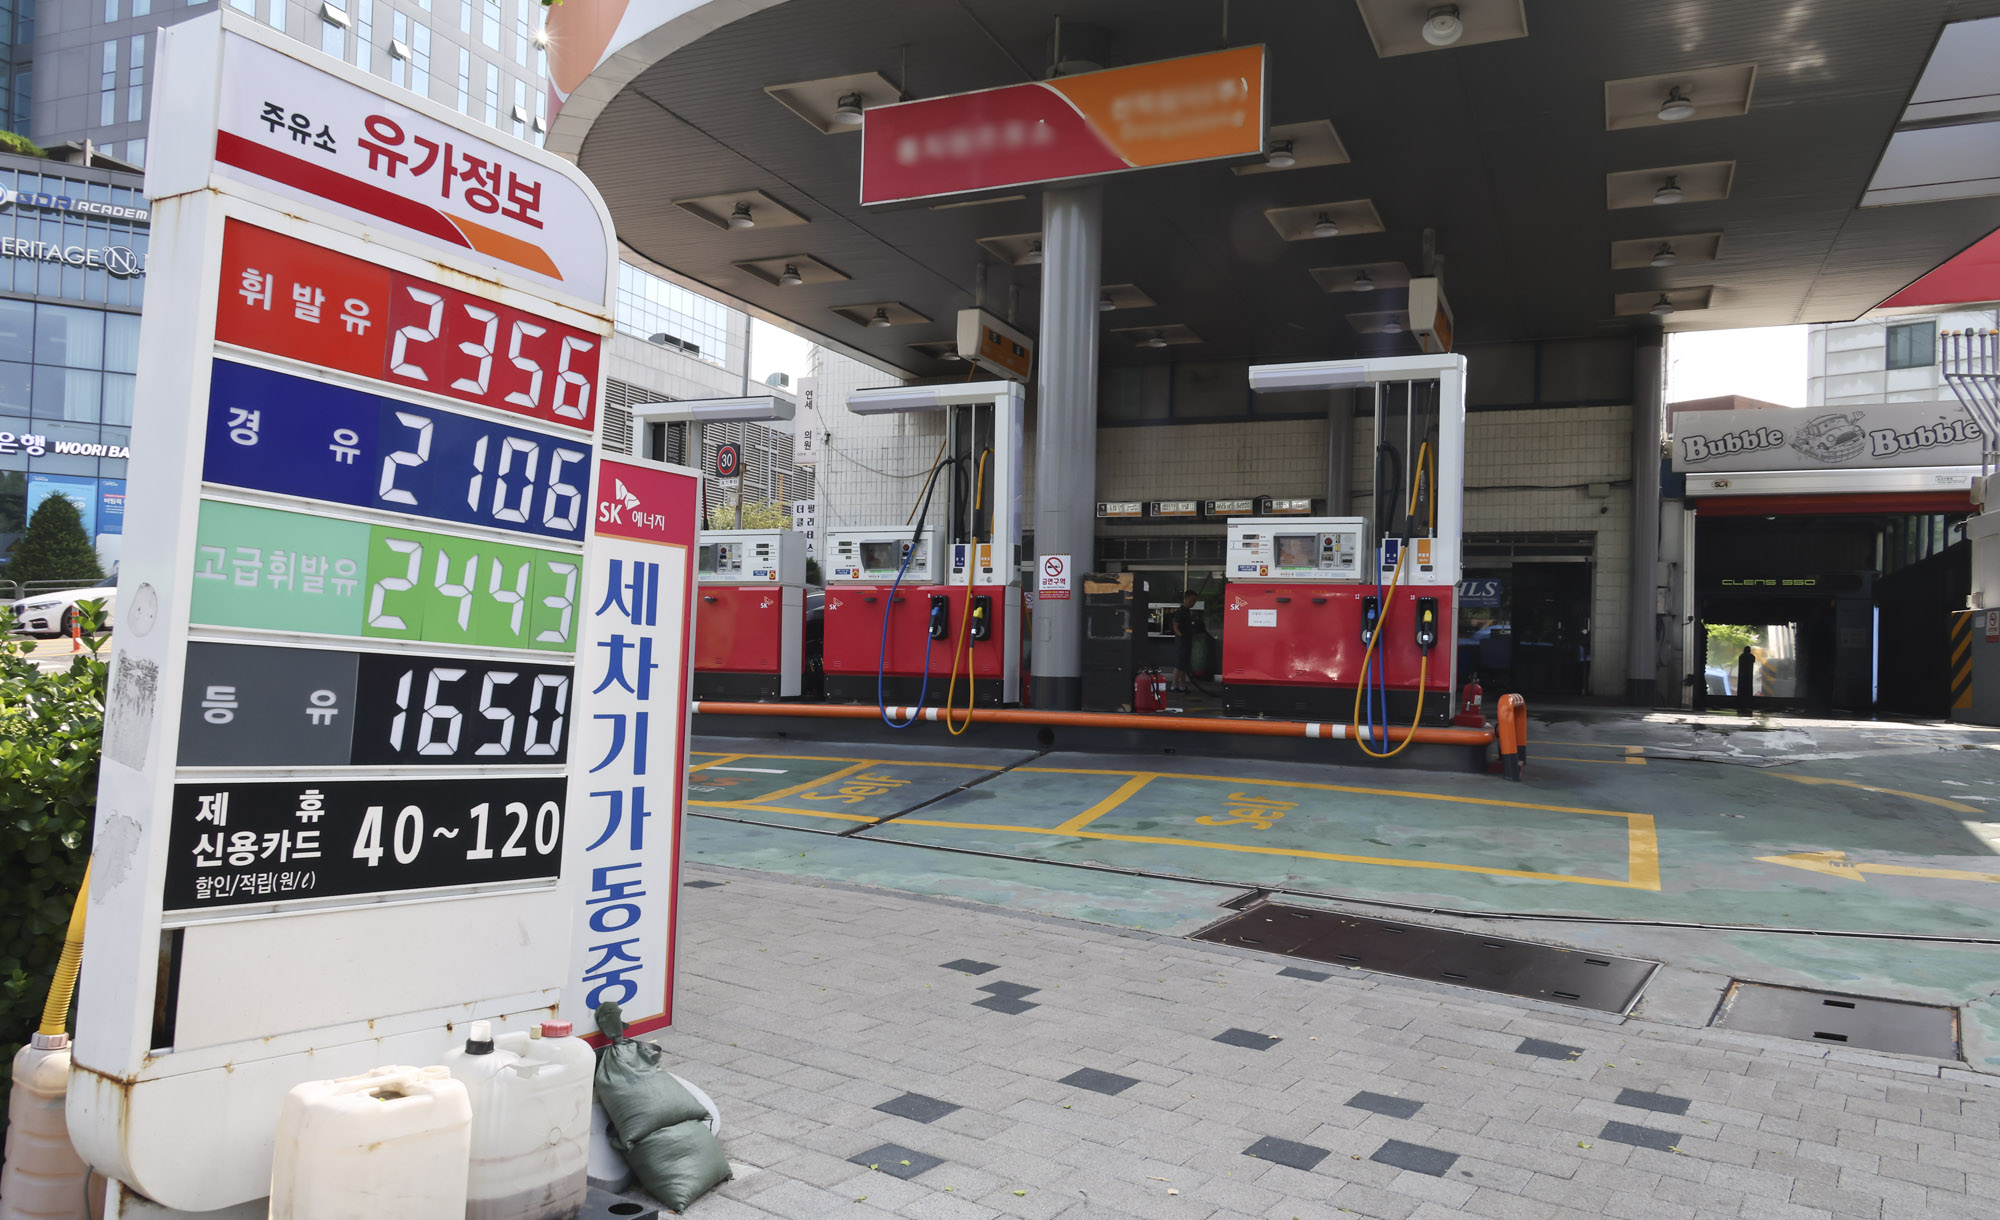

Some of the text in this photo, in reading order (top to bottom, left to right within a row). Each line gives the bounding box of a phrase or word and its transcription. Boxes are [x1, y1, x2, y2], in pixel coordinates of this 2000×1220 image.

[260, 101, 544, 230] 주유소 유가정보
[77, 201, 148, 220] ACADEM
[2, 237, 99, 267] ERITAGE
[390, 286, 594, 420] 2356
[0, 431, 129, 459] 은행 WOORI BA
[804, 430, 812, 450] 의원
[1682, 427, 1784, 463] Bubble
[1869, 420, 1981, 457] Bubble
[379, 411, 585, 531] 2106
[721, 453, 732, 467] 30
[599, 501, 665, 531] SK 에너지
[195, 538, 578, 643] 고급휘발유 2443
[1042, 578, 1066, 586] 금연구역
[1230, 603, 1240, 611] SK
[389, 667, 570, 756] 1650
[581, 558, 659, 1010] 세차기가동중
[191, 829, 322, 868] 신용카드
